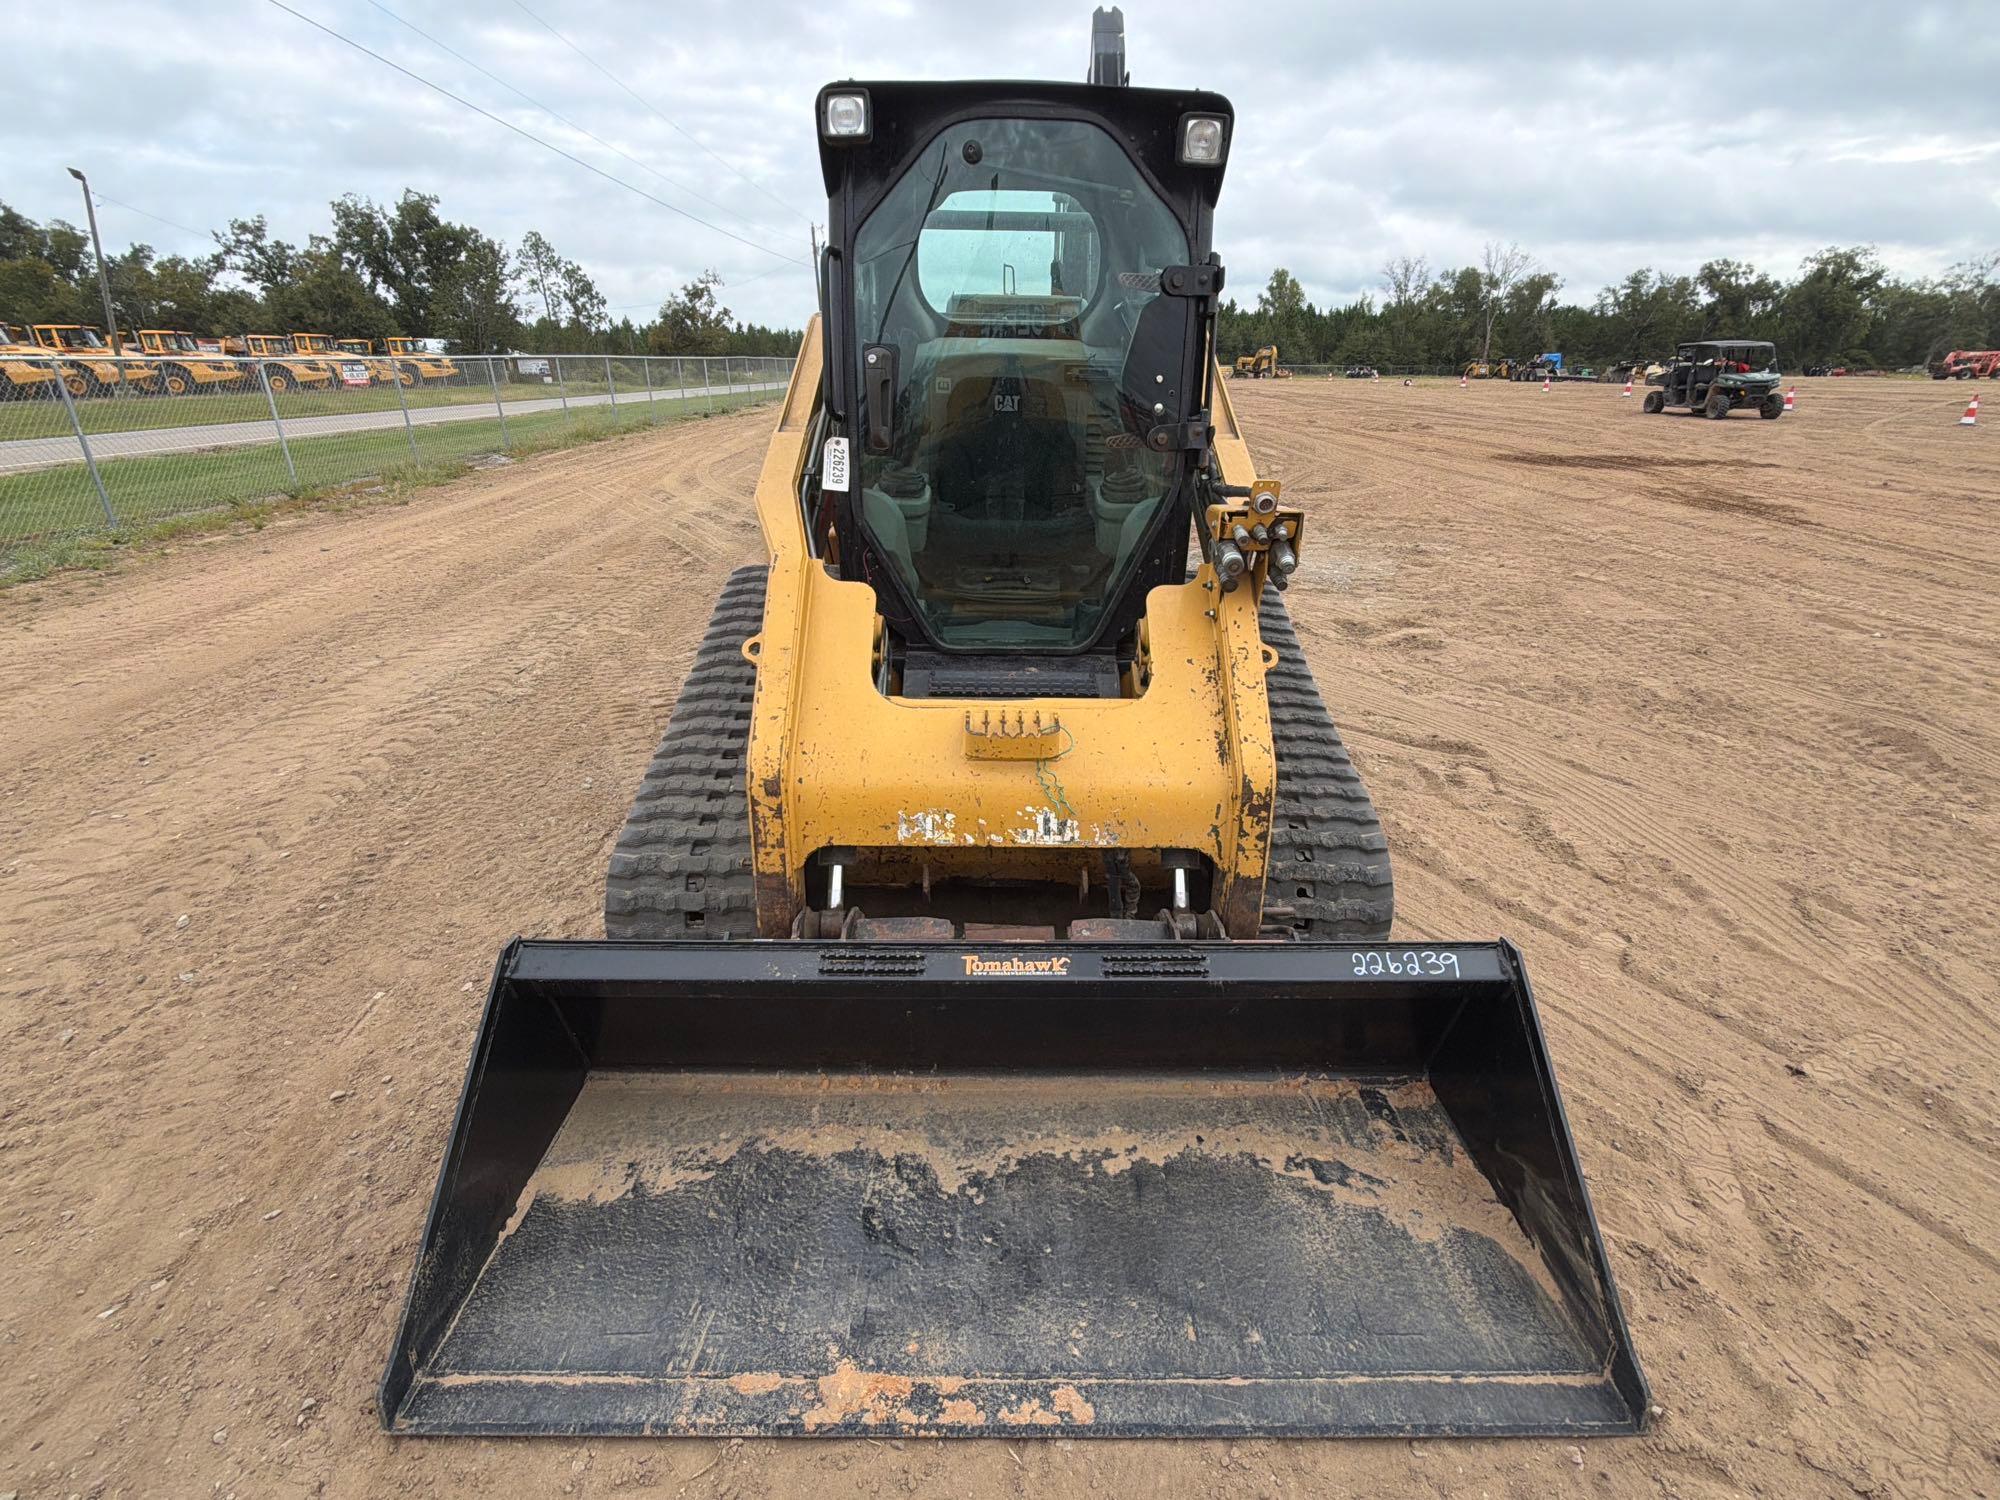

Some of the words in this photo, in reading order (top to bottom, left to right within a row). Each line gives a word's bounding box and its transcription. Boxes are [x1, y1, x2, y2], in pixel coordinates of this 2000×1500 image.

[995, 395, 1020, 411] CAT
[832, 448, 845, 484] 226239
[1352, 951, 1459, 979] 226239
